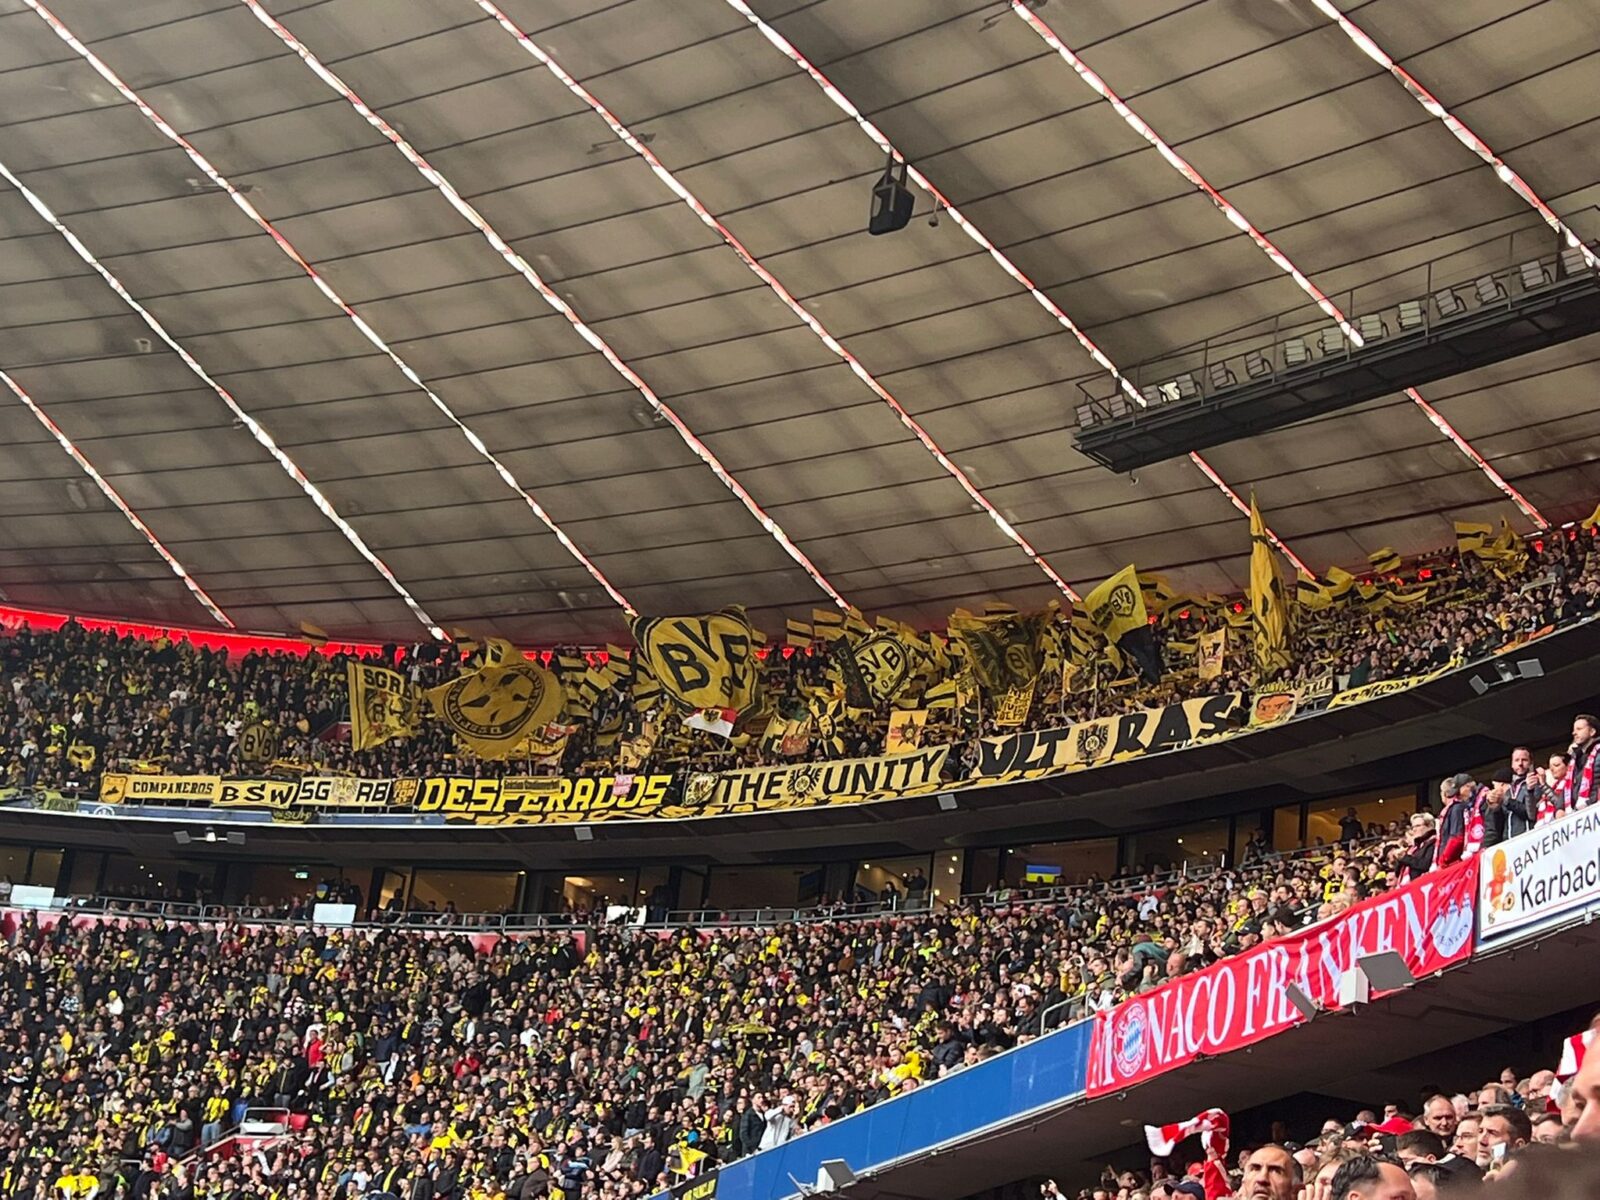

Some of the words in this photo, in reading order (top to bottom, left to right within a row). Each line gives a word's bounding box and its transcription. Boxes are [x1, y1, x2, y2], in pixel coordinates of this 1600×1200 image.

[244, 727, 272, 757] BVB
[301, 781, 331, 800] SG
[355, 782, 389, 801] RB
[719, 771, 790, 803] THE
[821, 749, 946, 796] UNITY
[219, 784, 294, 802] BSW
[1520, 847, 1600, 911] Karbac
